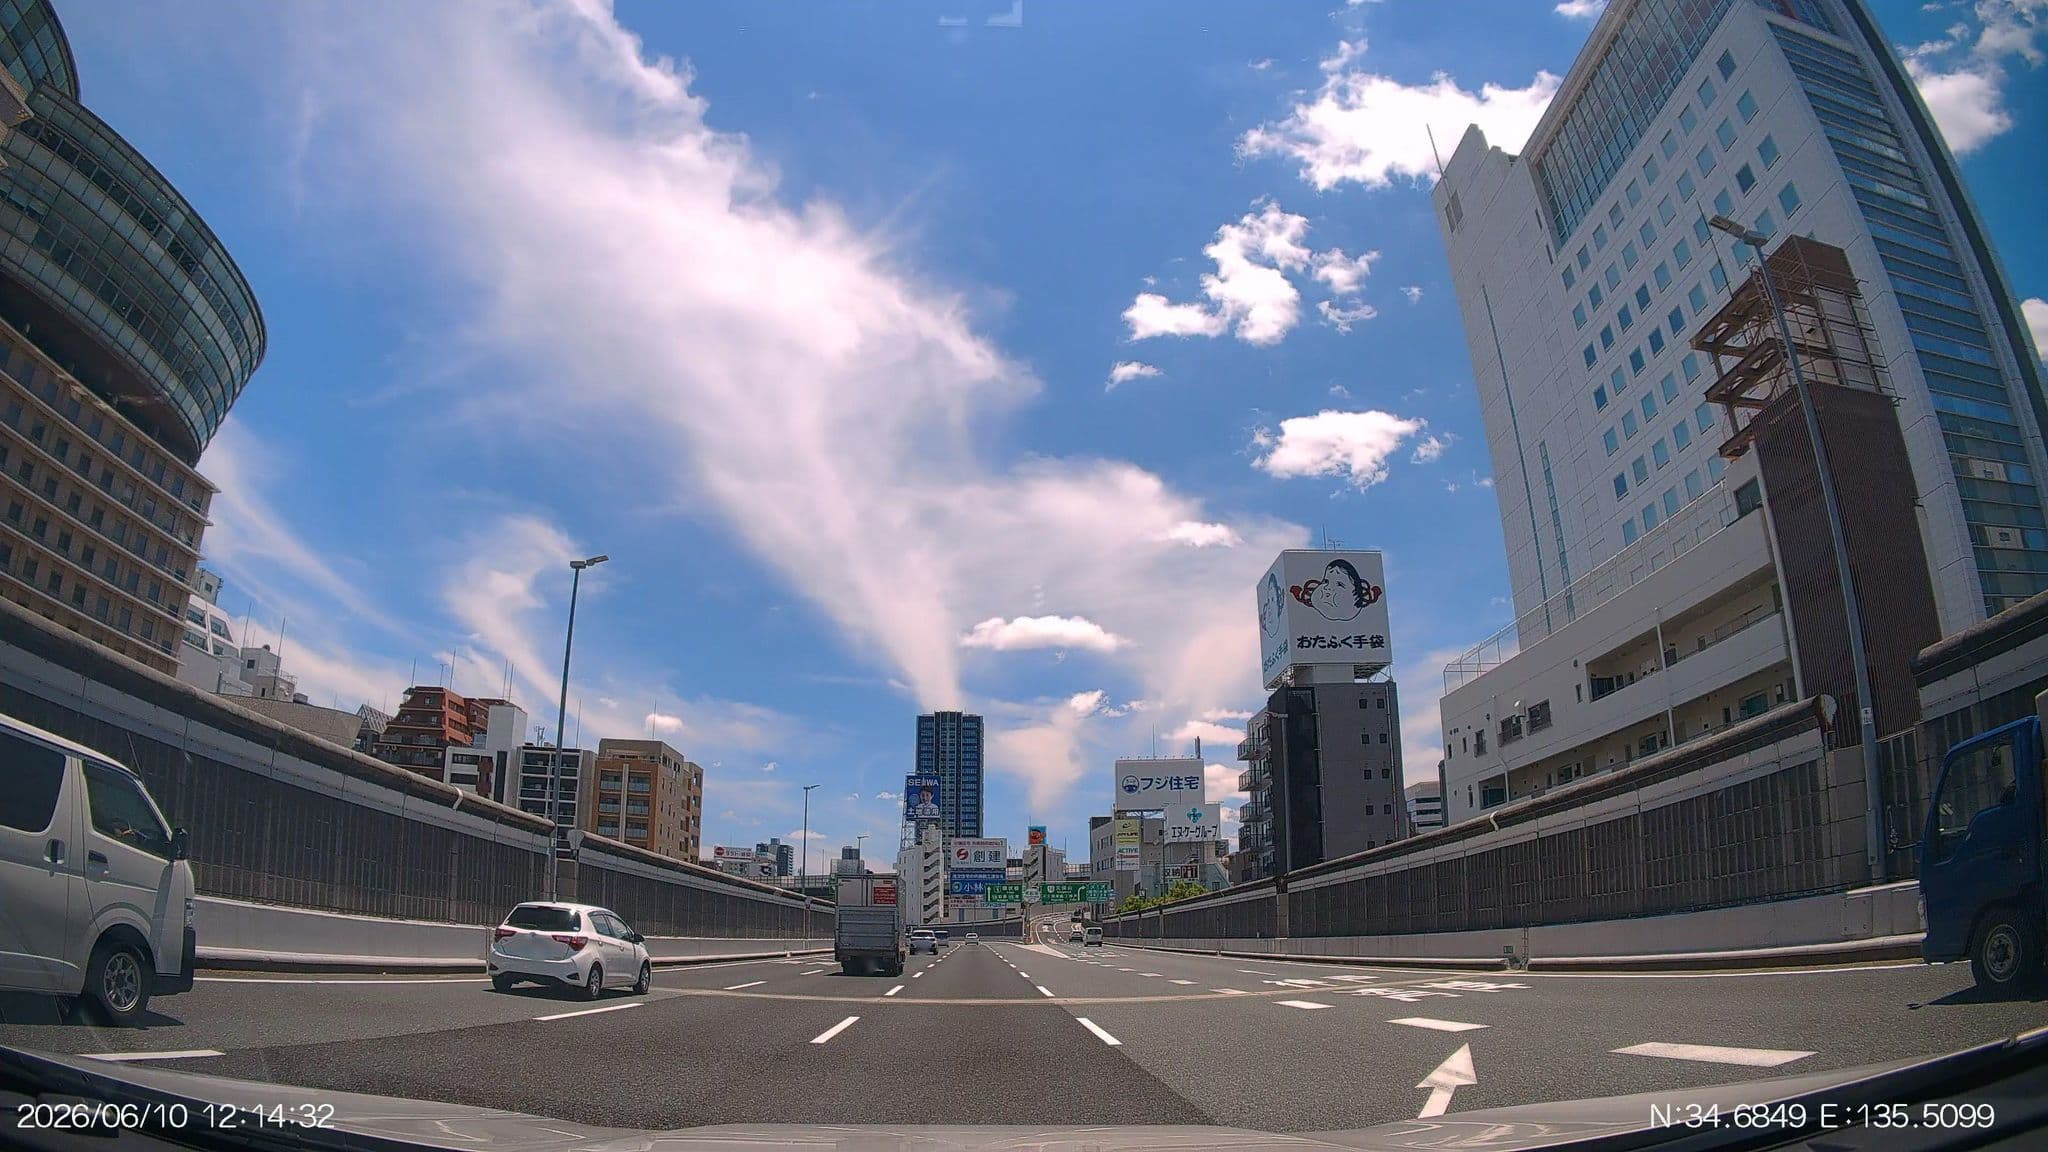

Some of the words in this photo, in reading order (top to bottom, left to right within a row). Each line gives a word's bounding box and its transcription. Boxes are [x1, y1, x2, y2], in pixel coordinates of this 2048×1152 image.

[1297, 634, 1385, 649] おたふく手袋
[1140, 775, 1200, 791] フジ住宅
[1171, 824, 1219, 838] エヌケーグループ
[973, 849, 1001, 863] 創建
